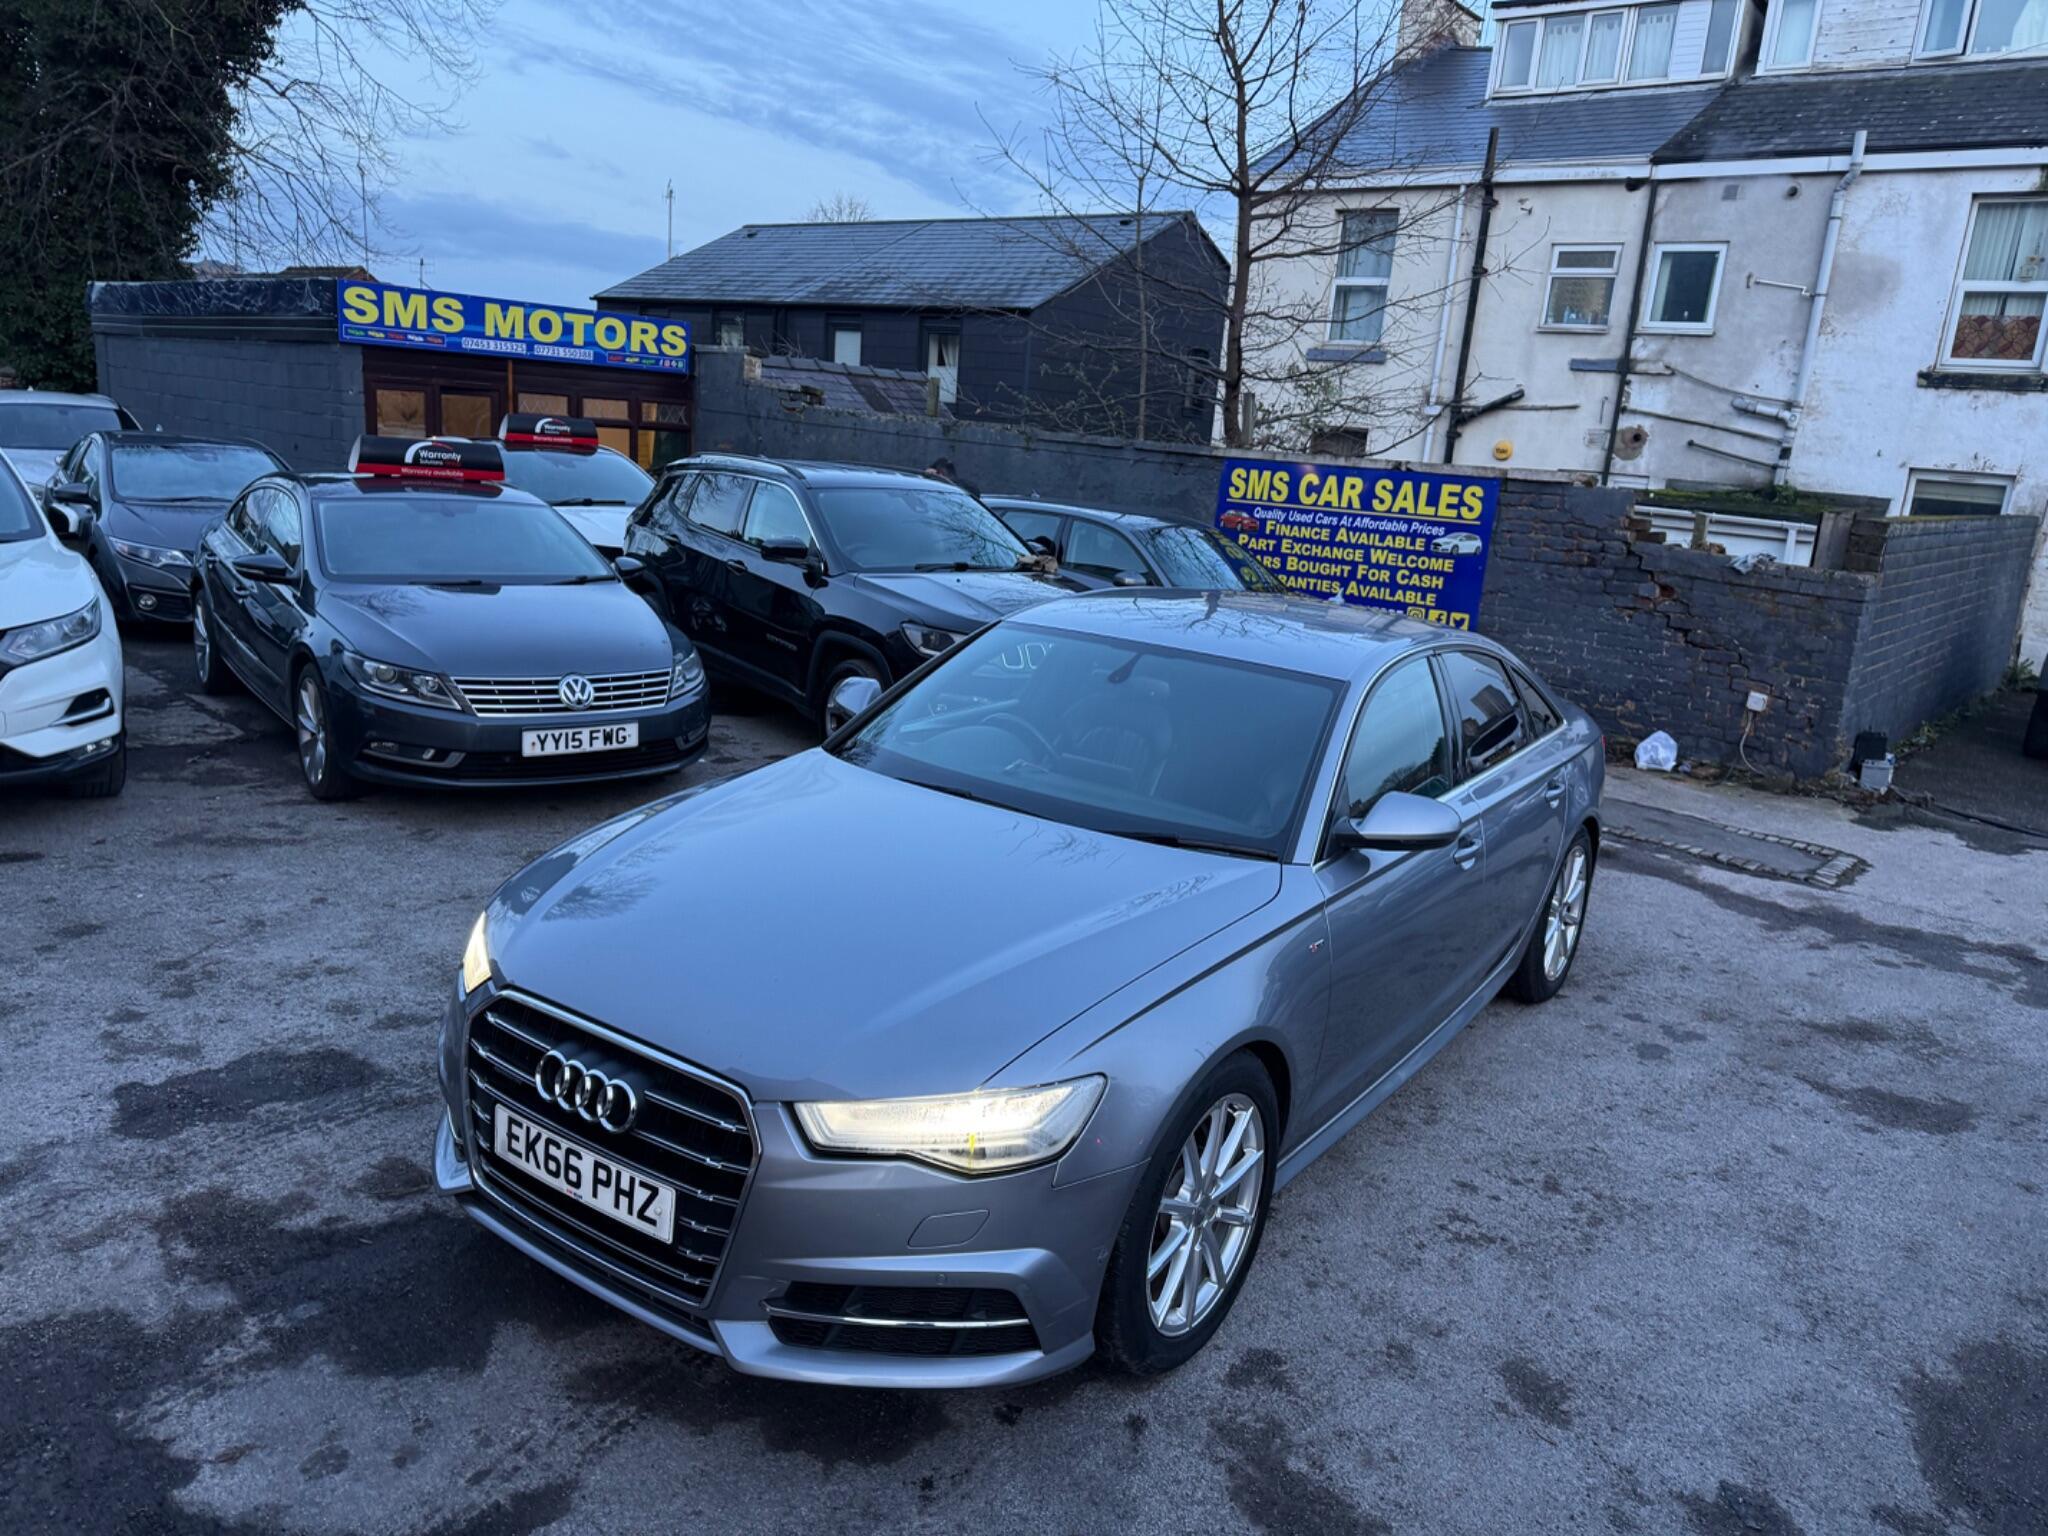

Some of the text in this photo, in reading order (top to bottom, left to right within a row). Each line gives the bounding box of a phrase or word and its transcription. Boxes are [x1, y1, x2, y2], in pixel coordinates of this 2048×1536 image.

[343, 286, 687, 357] SMS MOTORS
[418, 449, 462, 462] Warranty
[401, 467, 464, 477] Warranty available
[1228, 467, 1484, 520] SMS CAR SALES
[1253, 507, 1445, 536] Quality Used Cars At Affordable Prices
[1265, 520, 1426, 551] FINANCE AVAILABLE
[1238, 533, 1455, 573] PART EXCHANGE WELCOME
[1286, 556, 1353, 578] BOUGHT
[1356, 564, 1390, 583] FOR
[1396, 569, 1444, 590] CASH
[1345, 581, 1437, 607] AVAILABLE
[536, 726, 627, 752] YY15 FWG
[506, 1115, 660, 1228] EK66 PHZ
